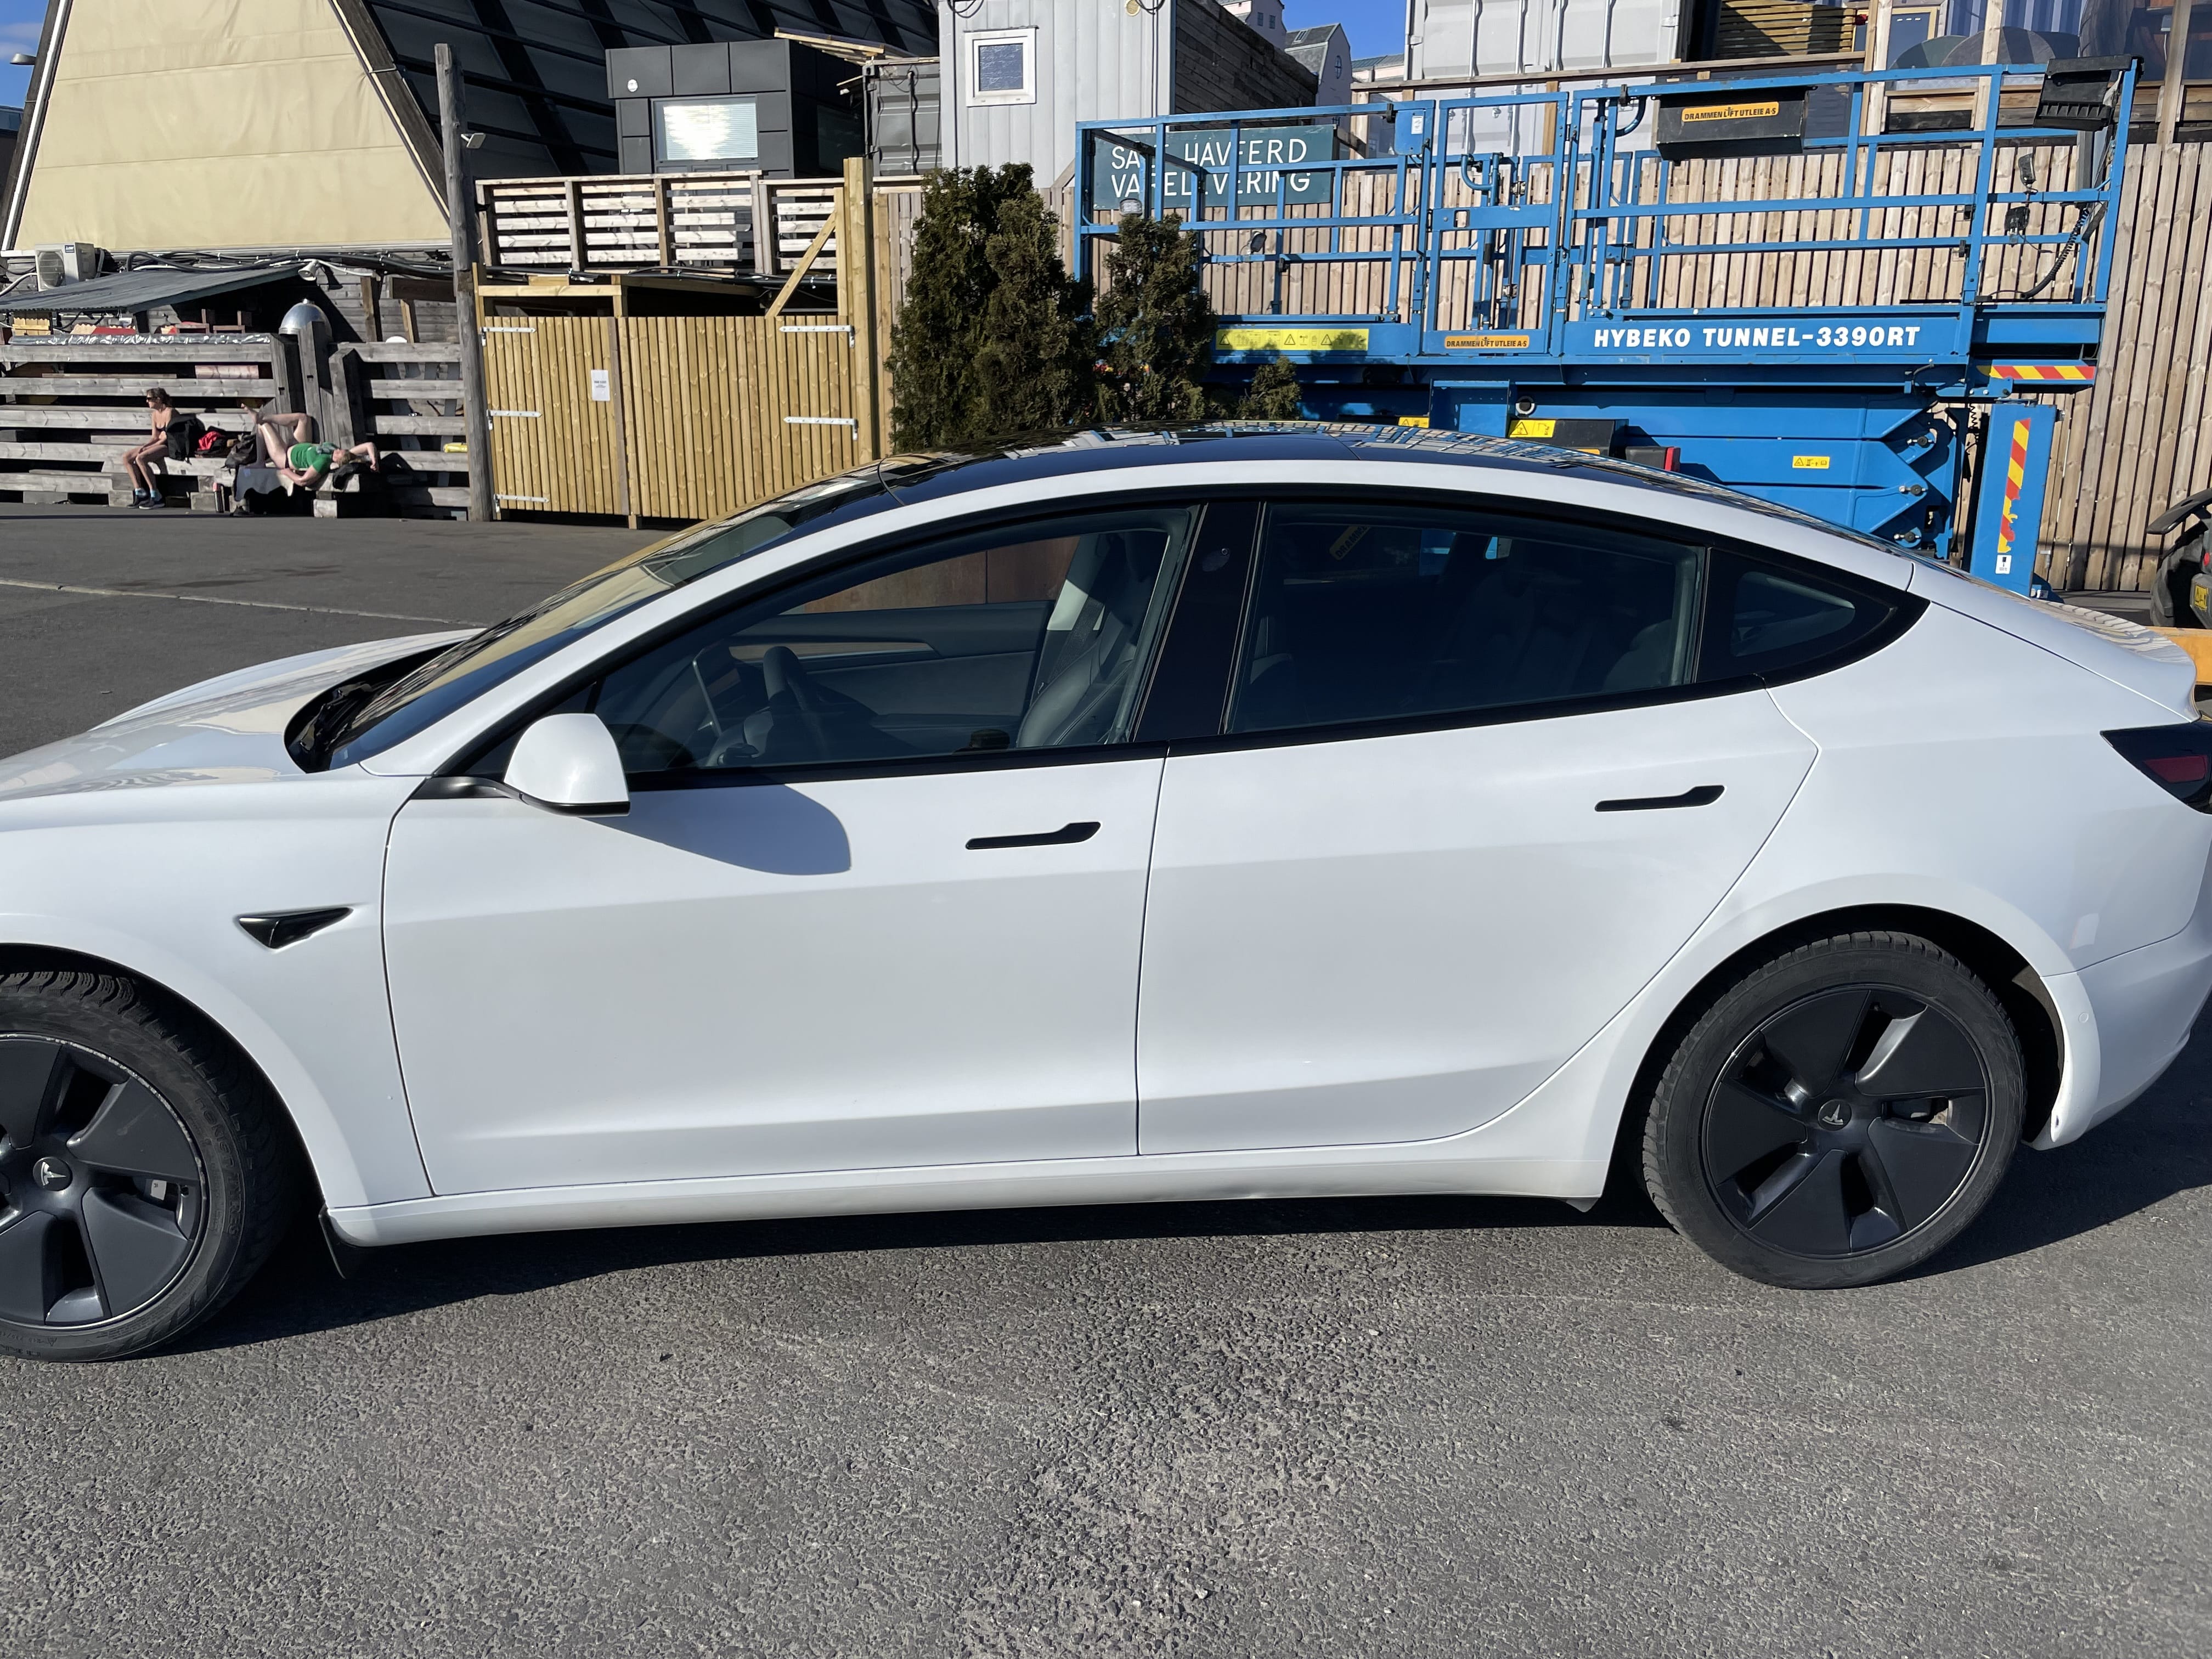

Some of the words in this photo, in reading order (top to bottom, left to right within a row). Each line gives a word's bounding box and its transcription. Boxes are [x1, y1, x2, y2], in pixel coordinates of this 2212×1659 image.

[1684, 111, 1723, 120] DRAMMEN
[1740, 108, 1764, 117] UTLEIE
[1111, 171, 1311, 198] VAELVRIG
[1594, 328, 1691, 347] HYBEKO
[1702, 326, 1921, 347] TUNNEL-3390RT
